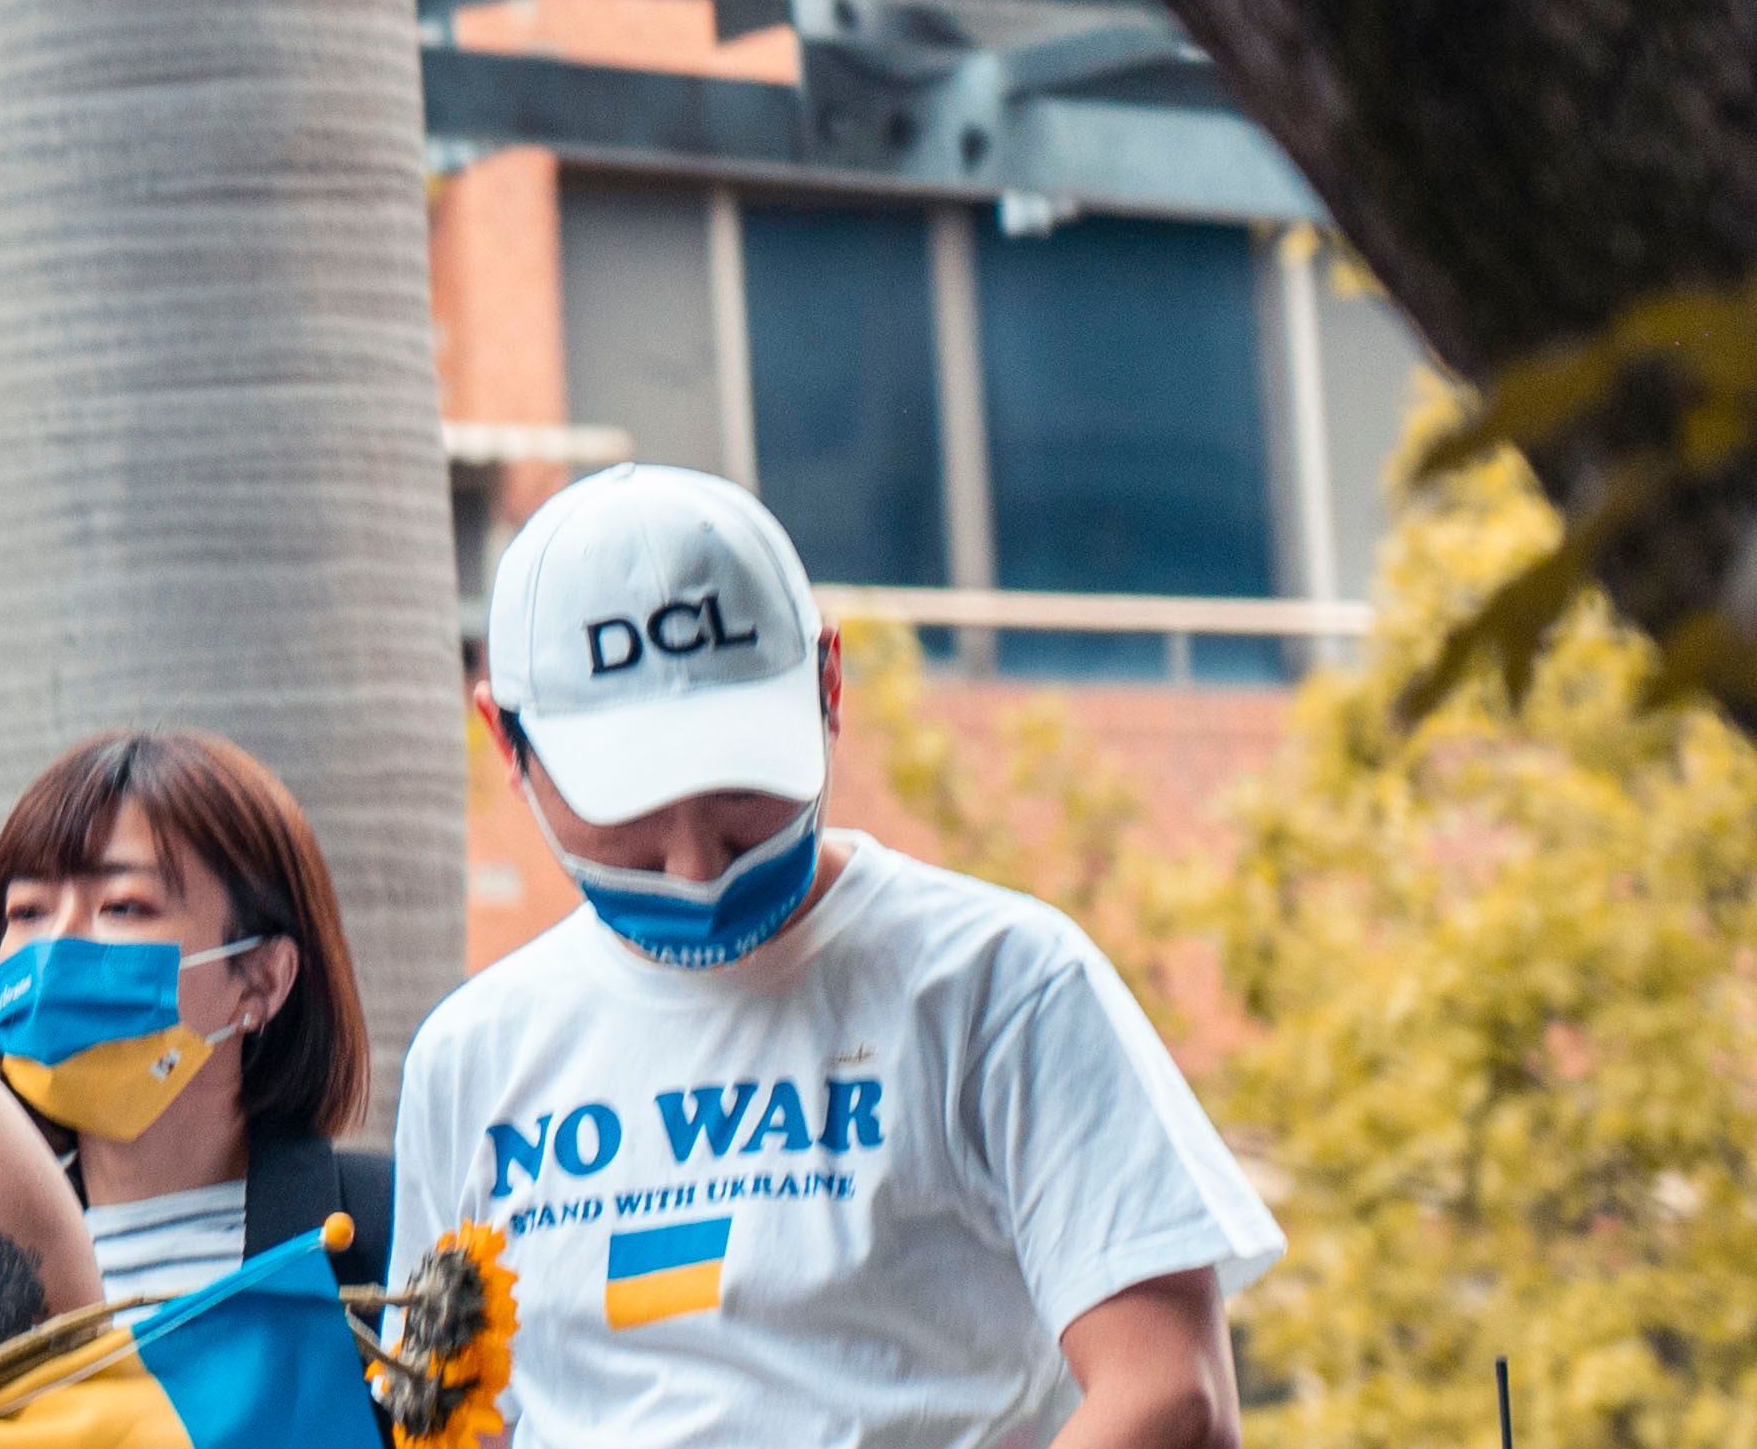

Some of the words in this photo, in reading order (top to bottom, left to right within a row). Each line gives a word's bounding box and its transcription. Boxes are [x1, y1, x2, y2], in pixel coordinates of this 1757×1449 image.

[587, 593, 758, 674] DCL
[485, 1102, 622, 1199] NO
[654, 1076, 885, 1163] WAR
[510, 1196, 604, 1235] STAND
[615, 1185, 696, 1216] WITH
[707, 1169, 857, 1203] UKRAINE
